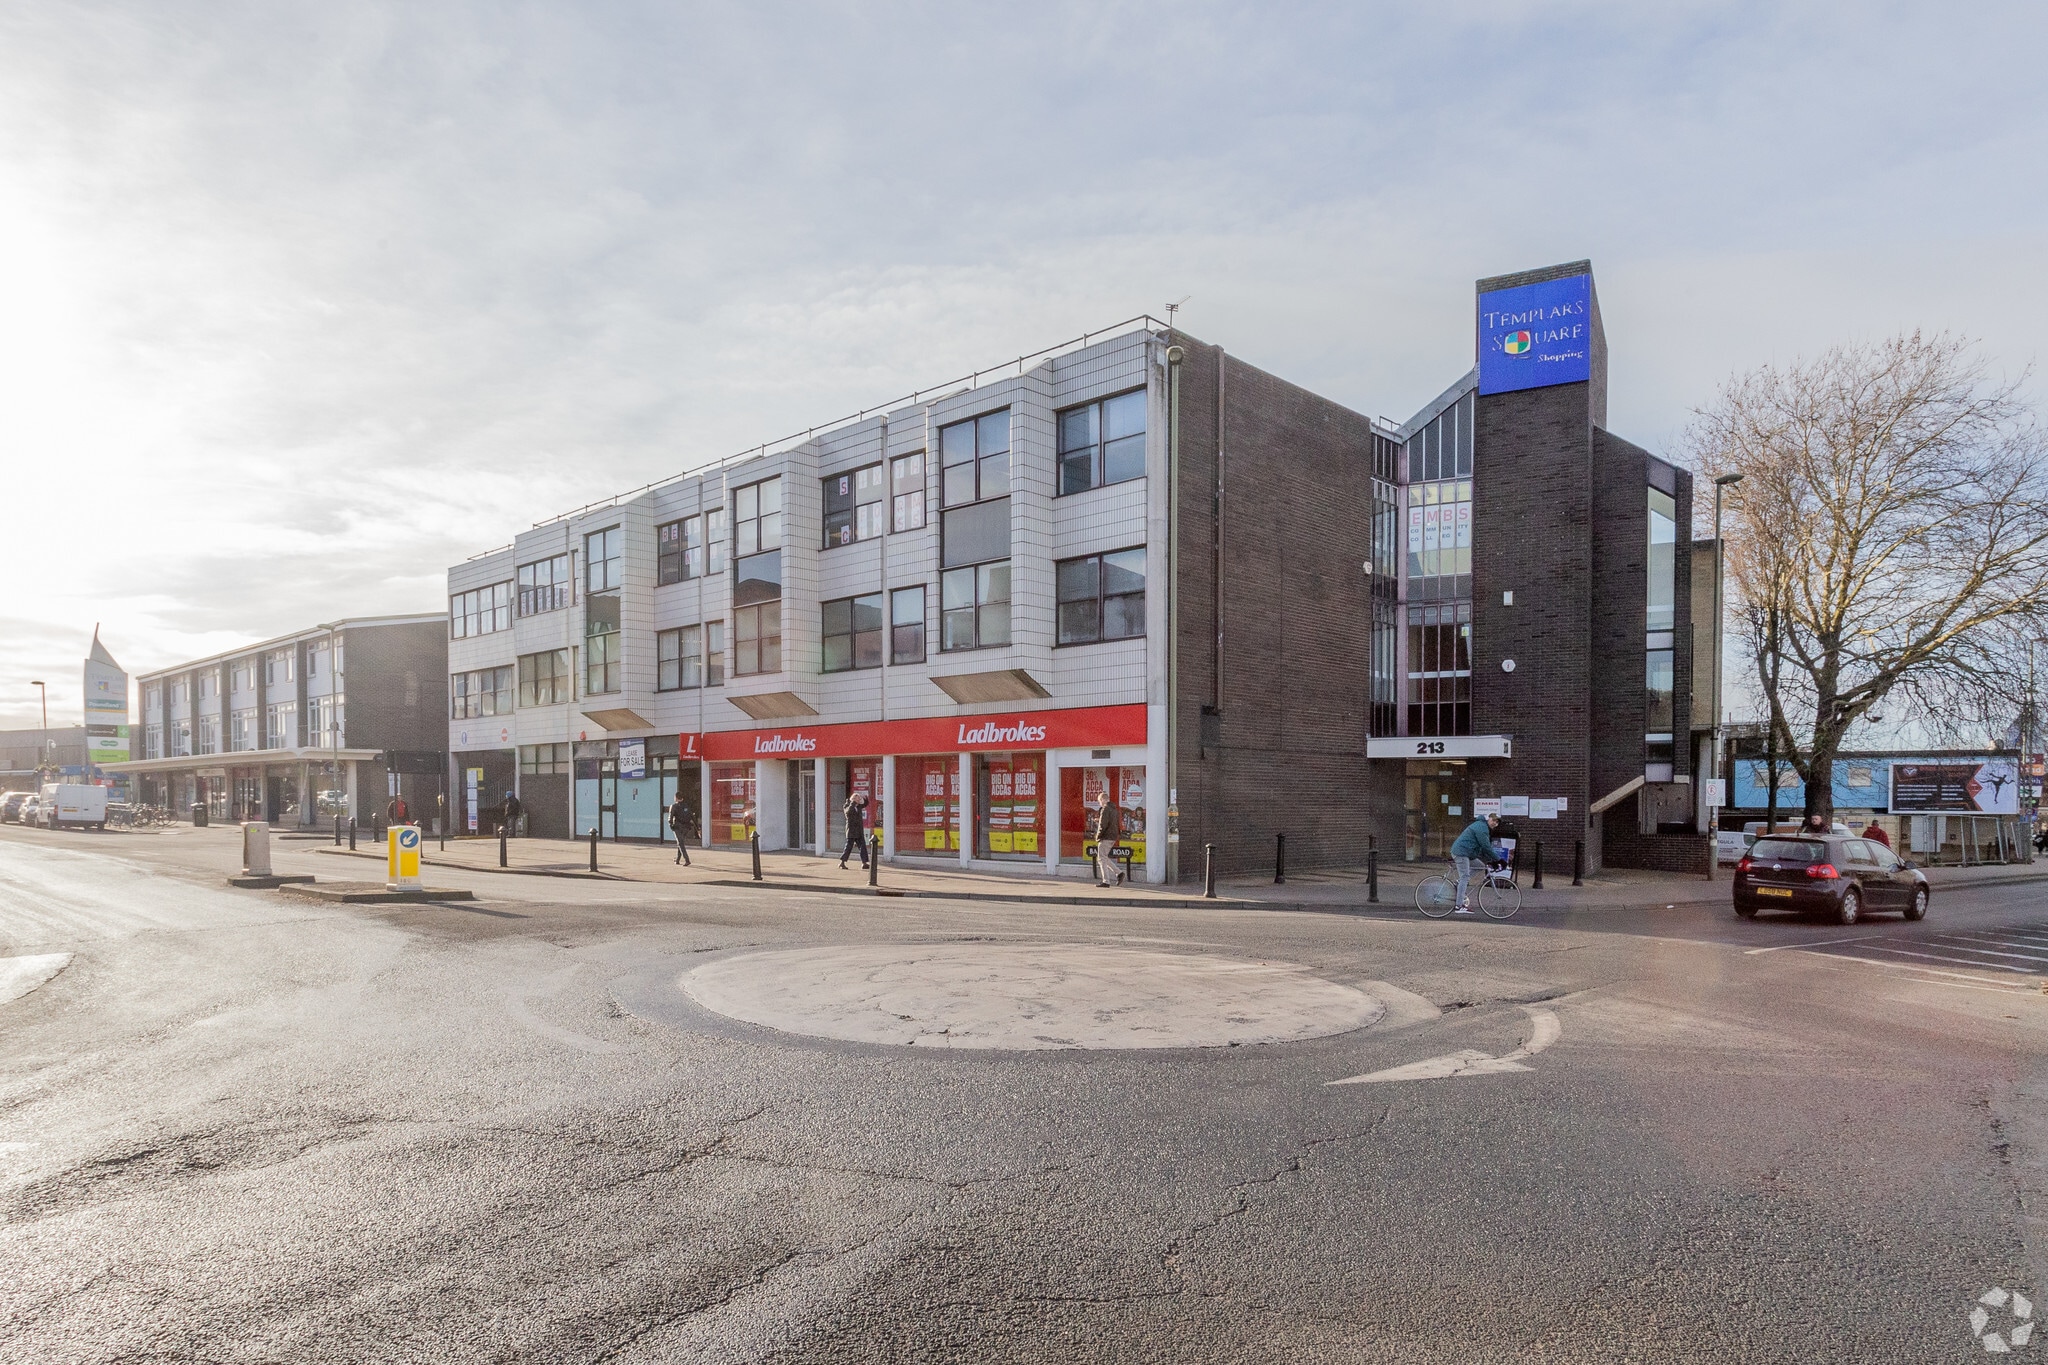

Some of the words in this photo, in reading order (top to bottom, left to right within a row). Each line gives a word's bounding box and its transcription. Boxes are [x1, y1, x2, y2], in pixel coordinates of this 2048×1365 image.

[1483, 300, 1584, 329] TEMPLARS
[1537, 349, 1584, 363] Shopping
[1412, 507, 1469, 525] EMBS
[957, 720, 1047, 744] Ladbrokes
[686, 735, 697, 753] L
[754, 733, 817, 753] Ladbrokes
[1417, 741, 1445, 754] 213
[620, 758, 630, 767] FOR
[631, 756, 644, 766] SALE
[991, 773, 1002, 785] BIG
[1002, 773, 1012, 785] ON
[1014, 772, 1026, 784] BIG
[1027, 772, 1036, 784] ON
[1113, 848, 1130, 856] ROAD
